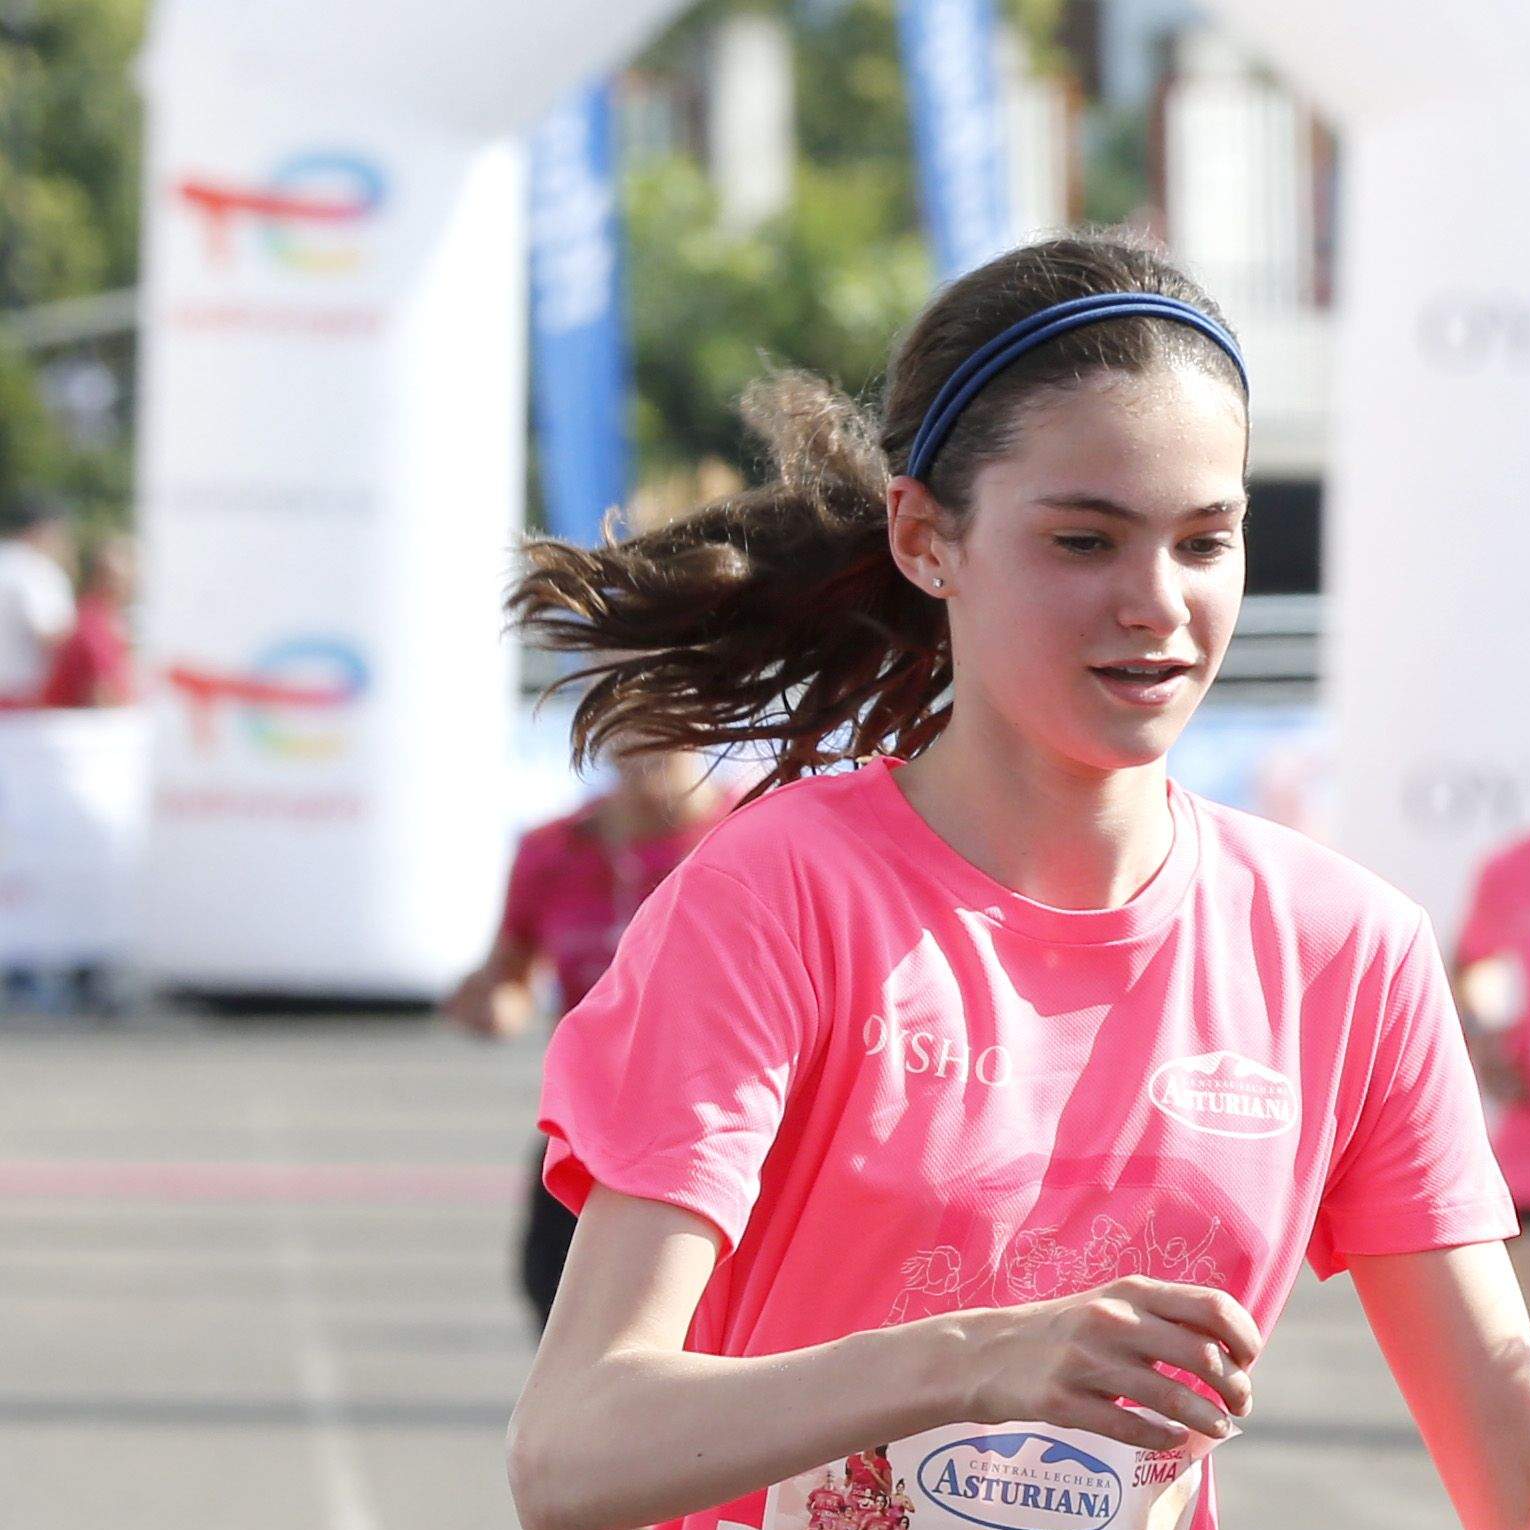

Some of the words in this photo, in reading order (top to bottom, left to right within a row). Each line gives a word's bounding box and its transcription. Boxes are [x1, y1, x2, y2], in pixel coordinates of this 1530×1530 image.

[932, 1458, 1111, 1518] ASTURIANA
[969, 1459, 1038, 1479] CENTRAL
[1044, 1471, 1111, 1489] LECHERA
[1132, 1462, 1177, 1487] SUMA
